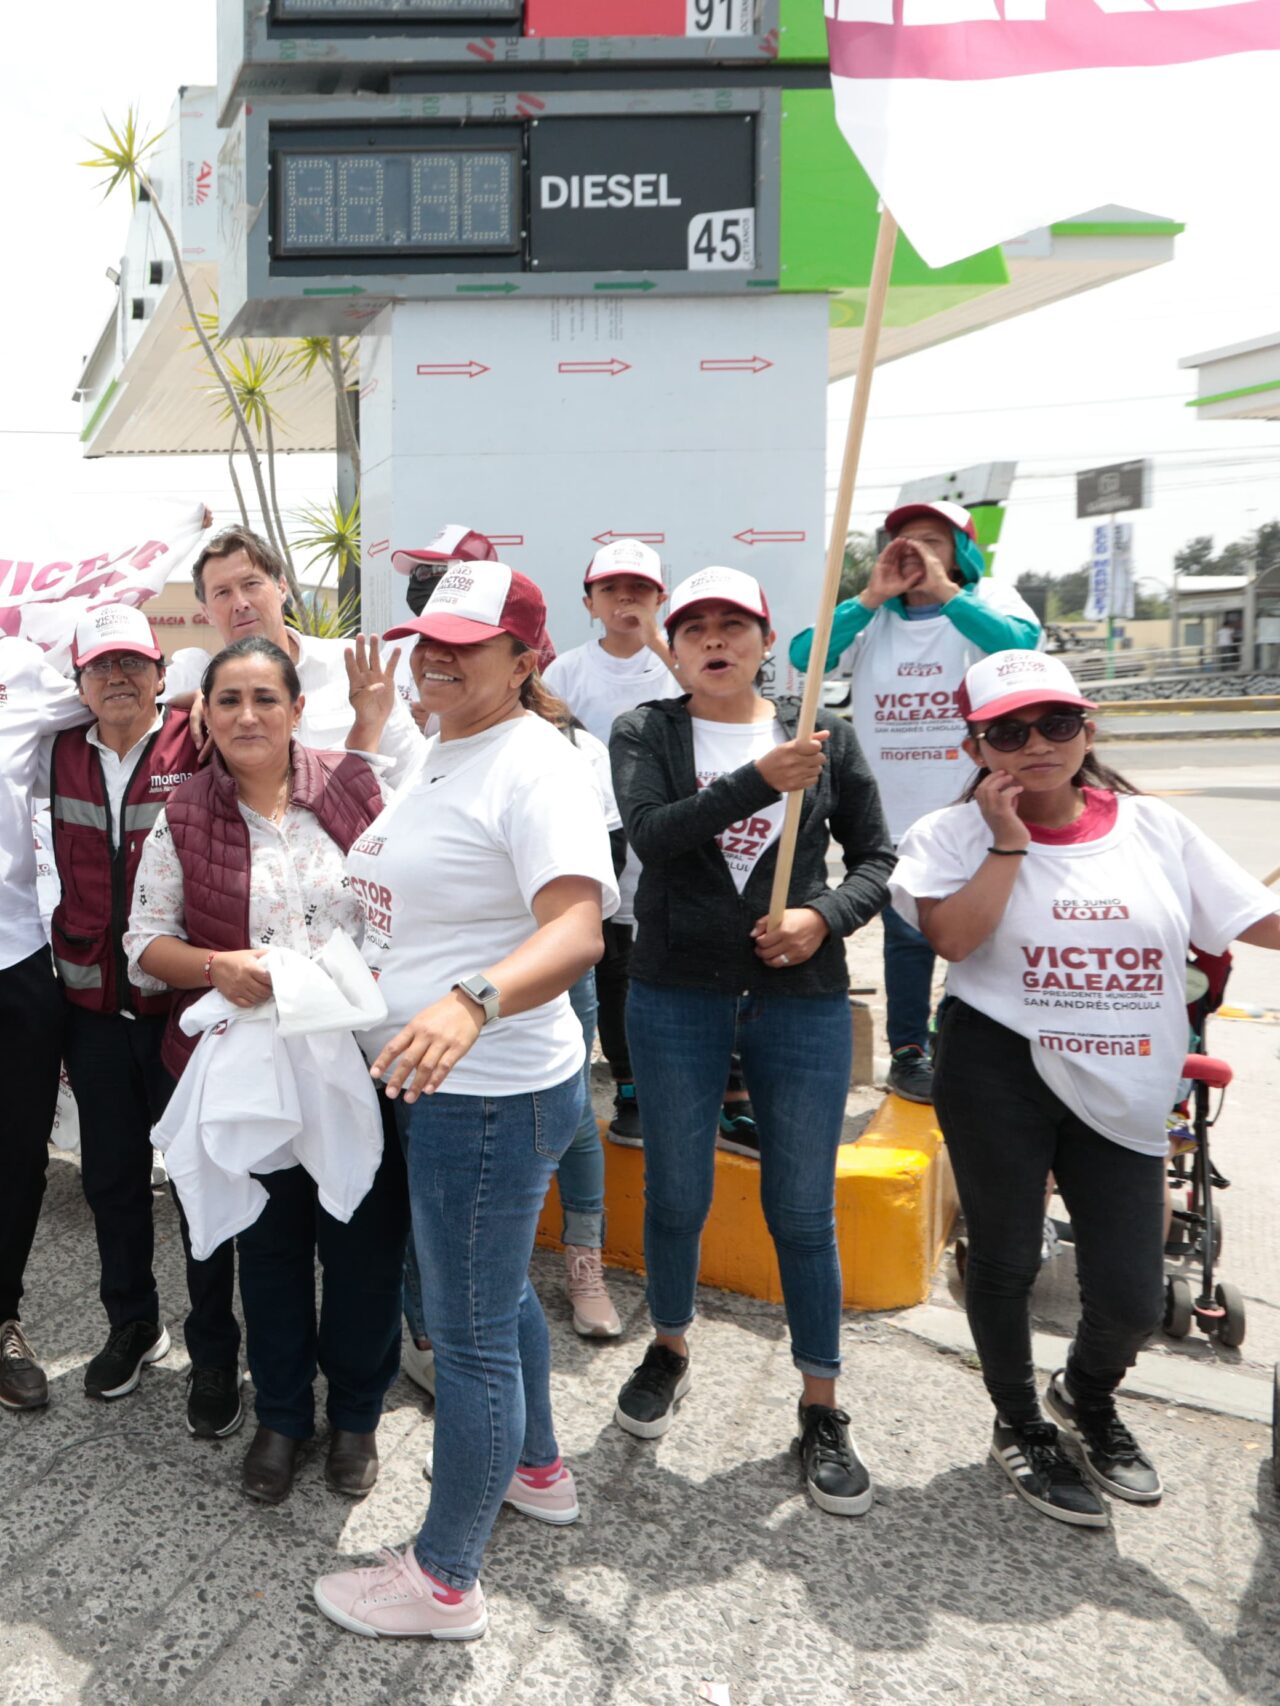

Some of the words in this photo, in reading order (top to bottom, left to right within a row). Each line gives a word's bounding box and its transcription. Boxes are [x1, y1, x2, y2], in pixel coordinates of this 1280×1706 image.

[693, 0, 734, 31] 91
[740, 0, 749, 33] OCTAN
[540, 173, 682, 209] DIESEL
[694, 218, 741, 263] 45
[743, 217, 751, 262] CETANOS
[874, 706, 964, 722] GALEAZZ
[880, 749, 942, 761] morena
[350, 876, 393, 912] CTOR
[1084, 898, 1122, 906] JUNIO
[1056, 907, 1125, 919] VOTA
[1021, 946, 1163, 971] VICTOR
[1022, 971, 1163, 992] GALEAZZI
[1024, 997, 1050, 1008] SAN
[1053, 1000, 1110, 1011] ANDRÉS
[1112, 1000, 1161, 1011] CHOLULA
[1042, 990, 1103, 999] PRESIDENTE
[1105, 991, 1148, 999] MUNICIPAL
[1039, 1035, 1136, 1056] morena
